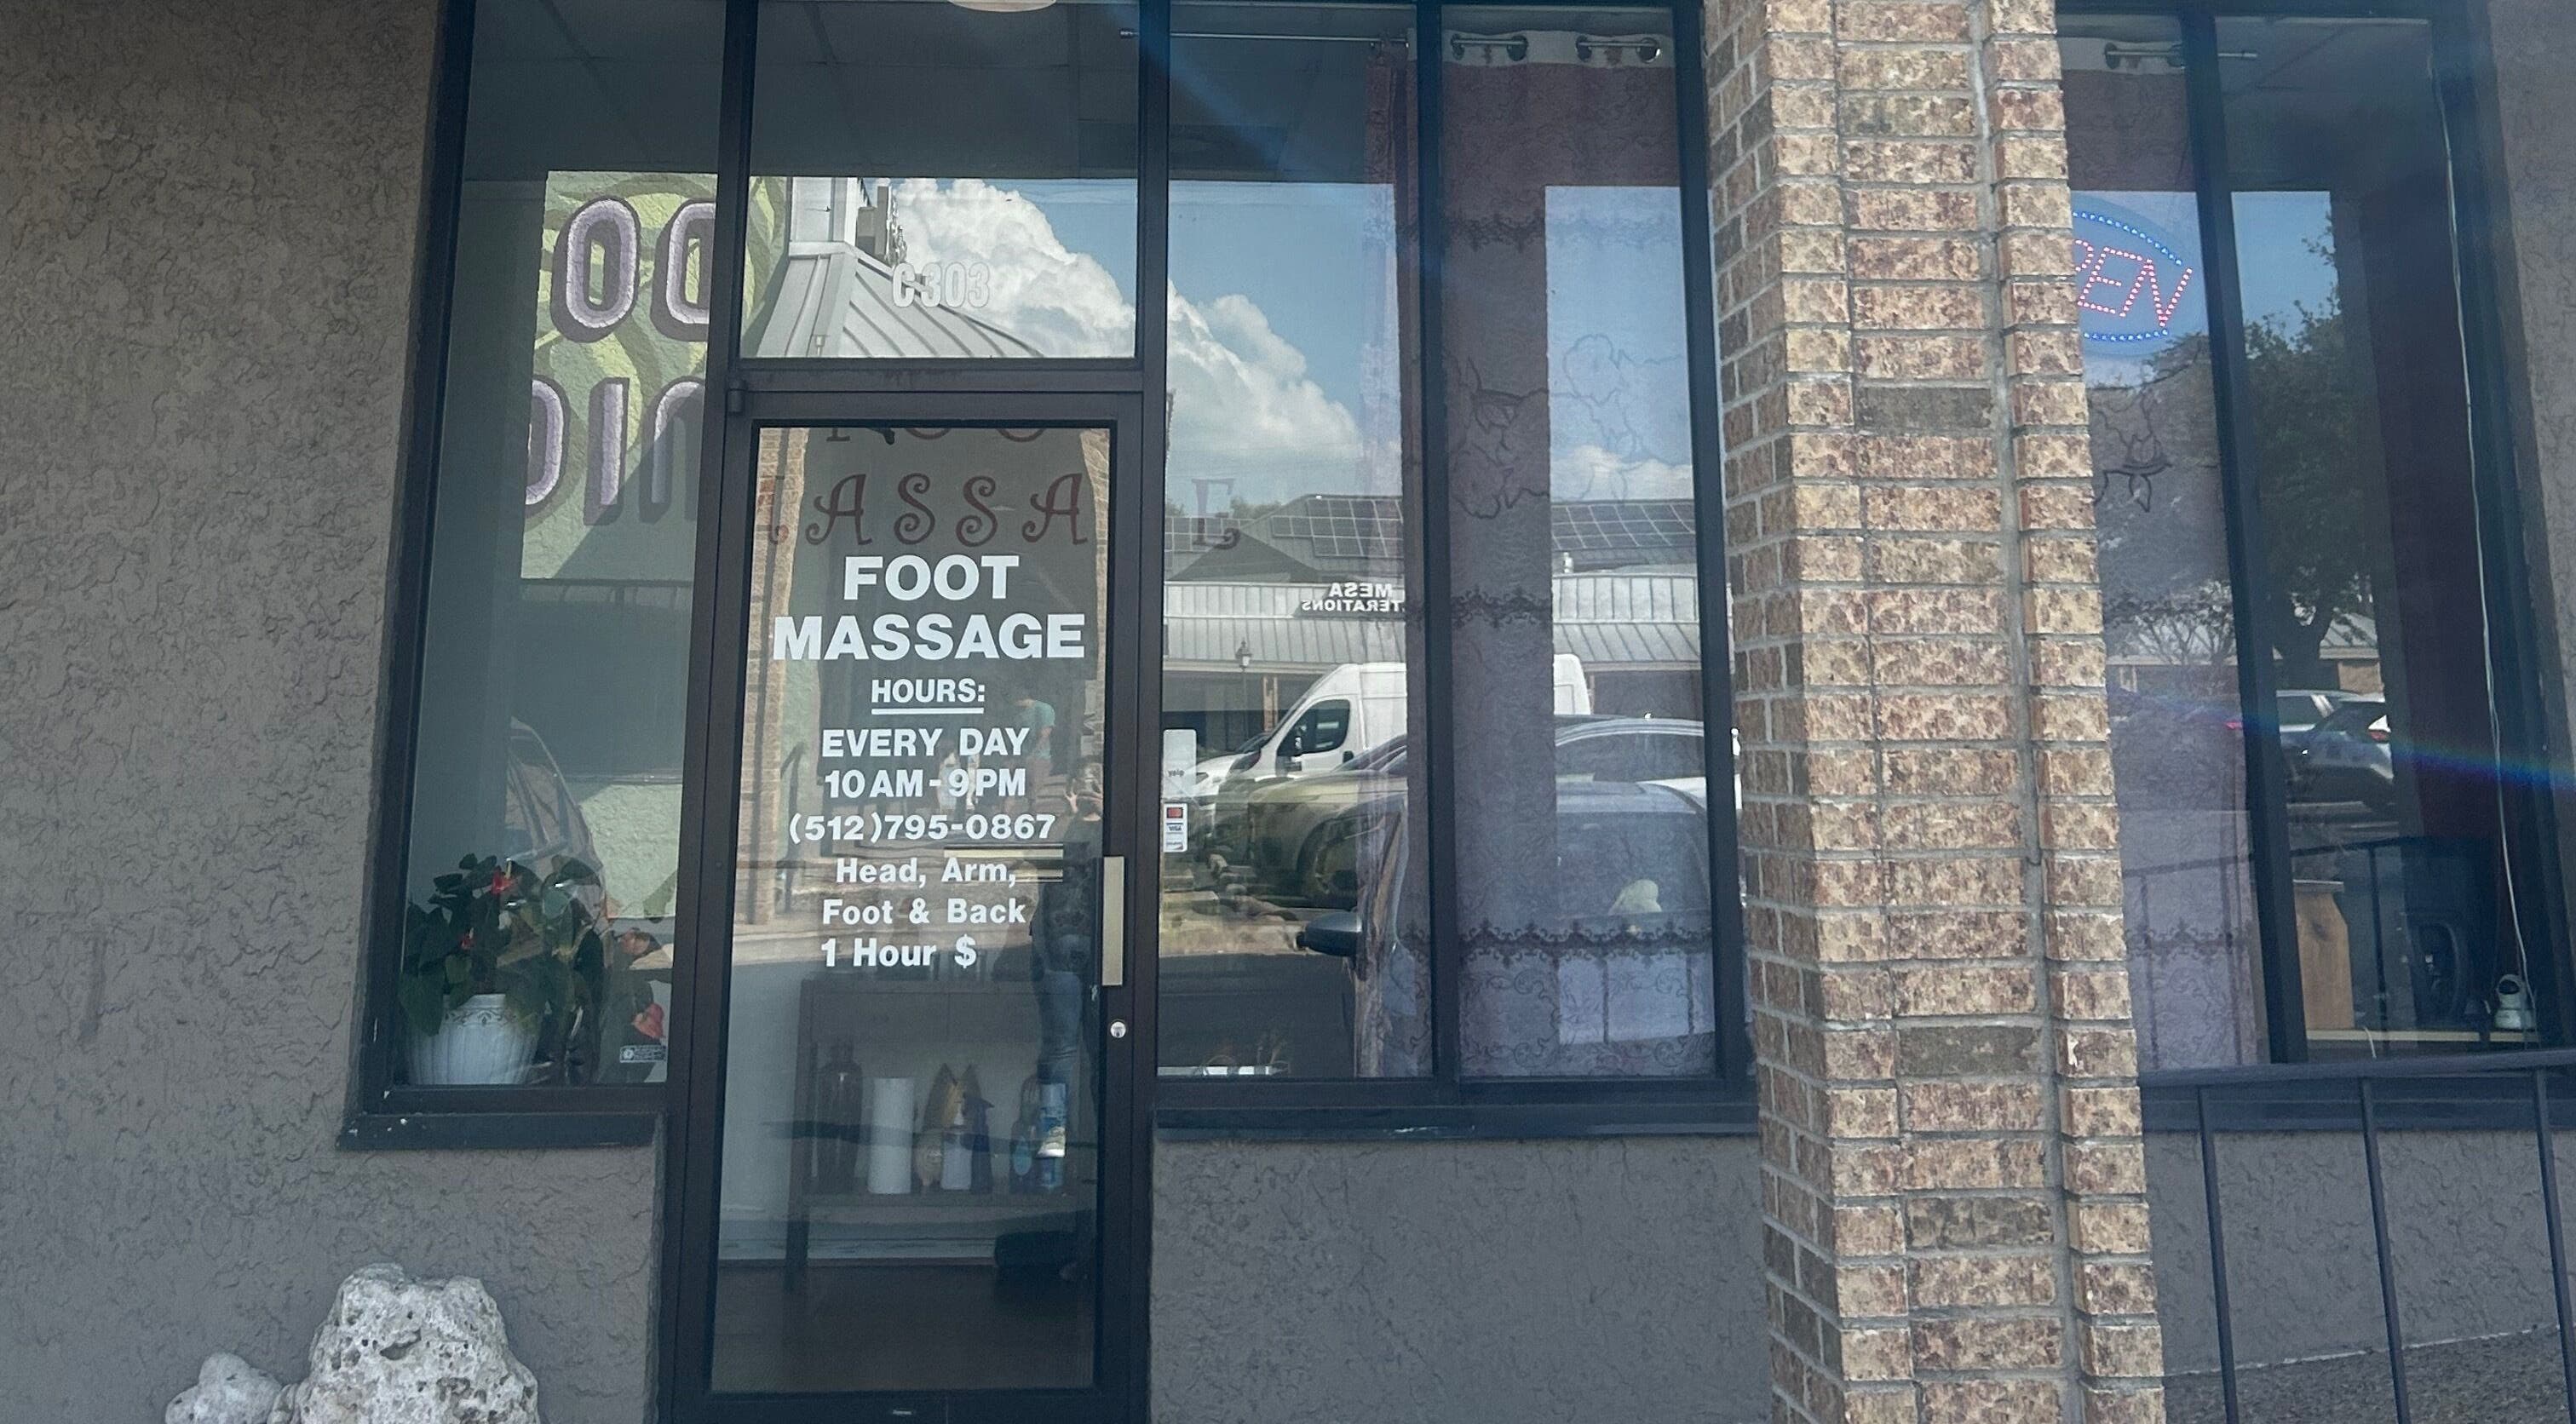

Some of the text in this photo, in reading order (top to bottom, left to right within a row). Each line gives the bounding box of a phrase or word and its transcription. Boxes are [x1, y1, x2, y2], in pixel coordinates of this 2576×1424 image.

[892, 261, 991, 307] C303
[843, 554, 1020, 601] FOOT
[773, 612, 1085, 660] MASSAGE
[871, 678, 985, 703] HOURS:
[822, 727, 1030, 757] EVERY DAY
[837, 858, 1016, 887] Head, Arm,
[822, 898, 1026, 925] Foot & Back
[821, 933, 977, 968] 1 Hour $
